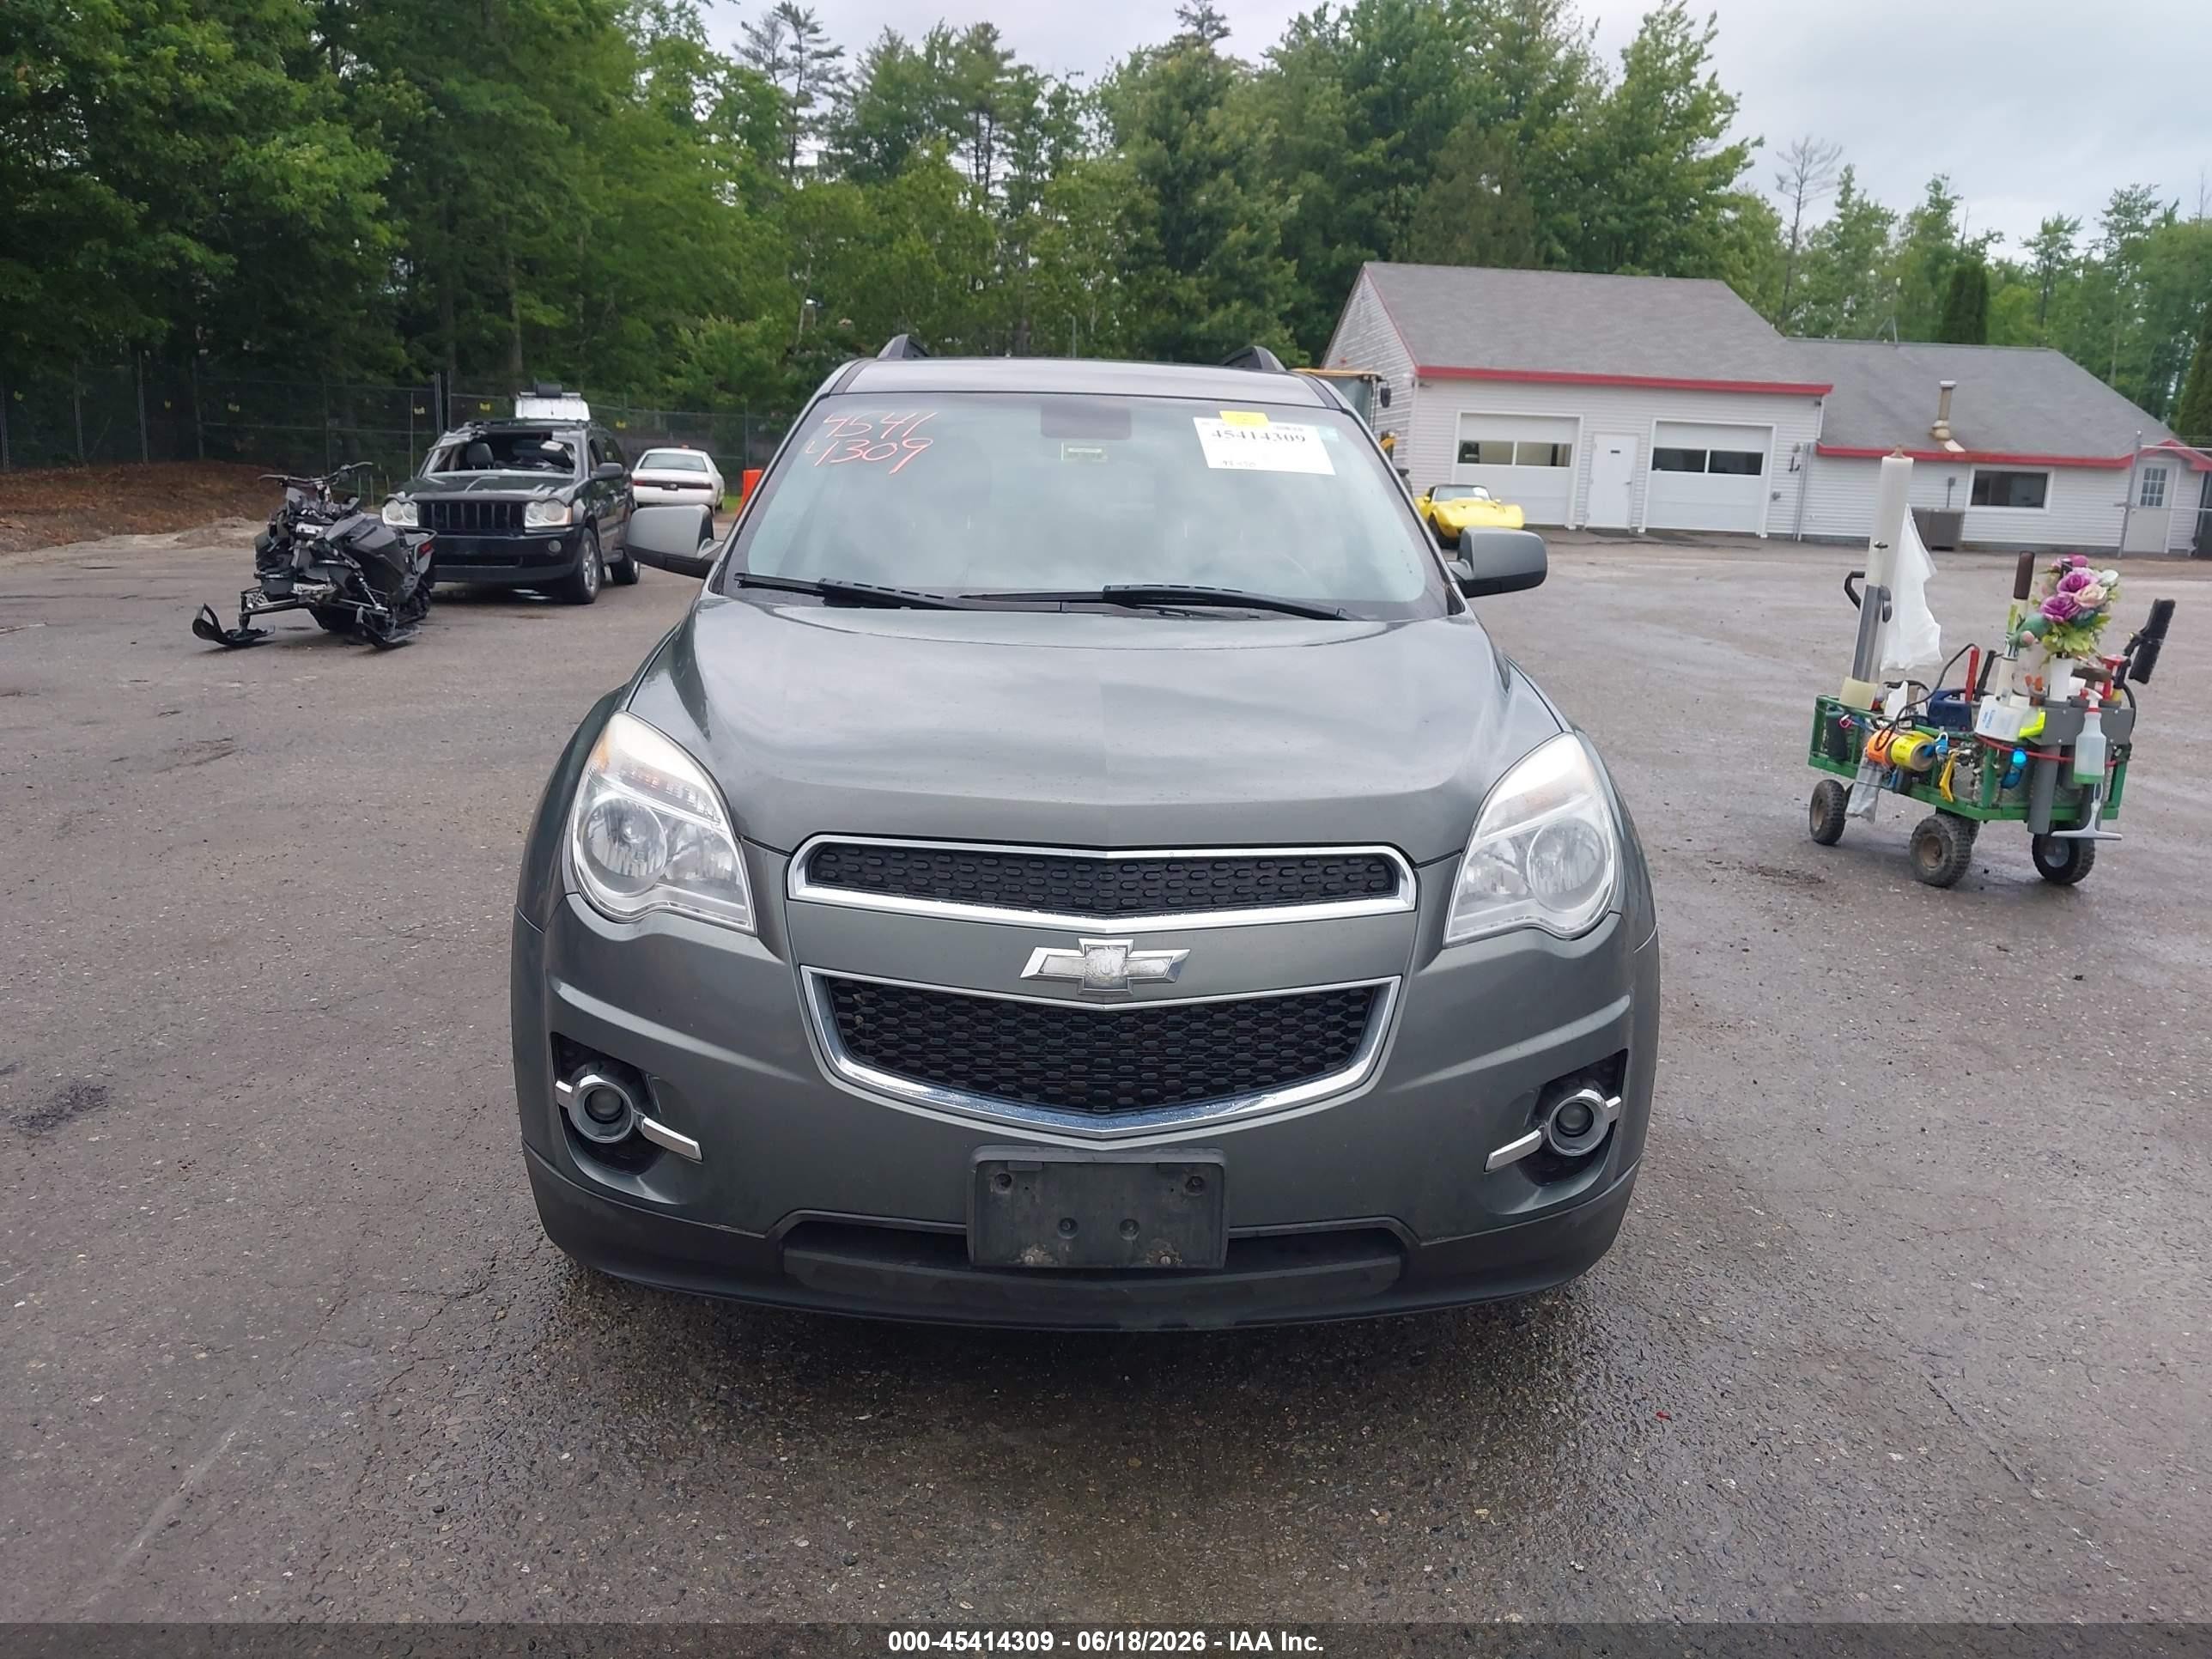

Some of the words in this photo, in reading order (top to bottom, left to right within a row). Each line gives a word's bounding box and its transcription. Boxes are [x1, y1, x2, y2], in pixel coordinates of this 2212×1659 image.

[823, 410, 939, 440] 4541
[1211, 428, 1306, 443] 45414309
[805, 437, 934, 475] 4309
